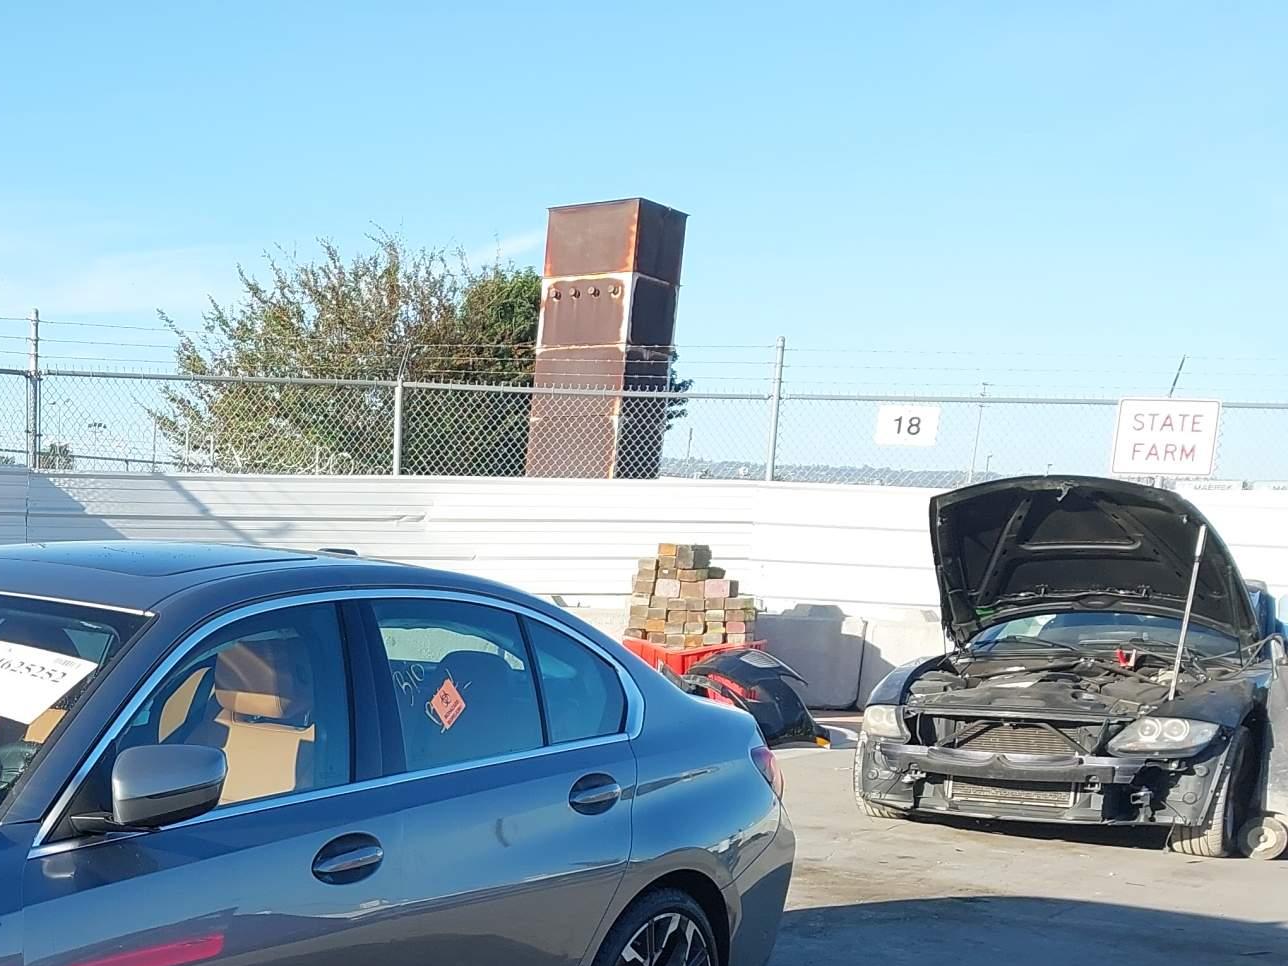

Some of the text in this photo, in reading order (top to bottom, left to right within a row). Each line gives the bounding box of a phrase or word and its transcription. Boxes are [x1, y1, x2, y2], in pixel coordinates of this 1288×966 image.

[894, 416, 922, 436] 18
[1132, 413, 1203, 433] STATE
[1131, 443, 1196, 462] FARM
